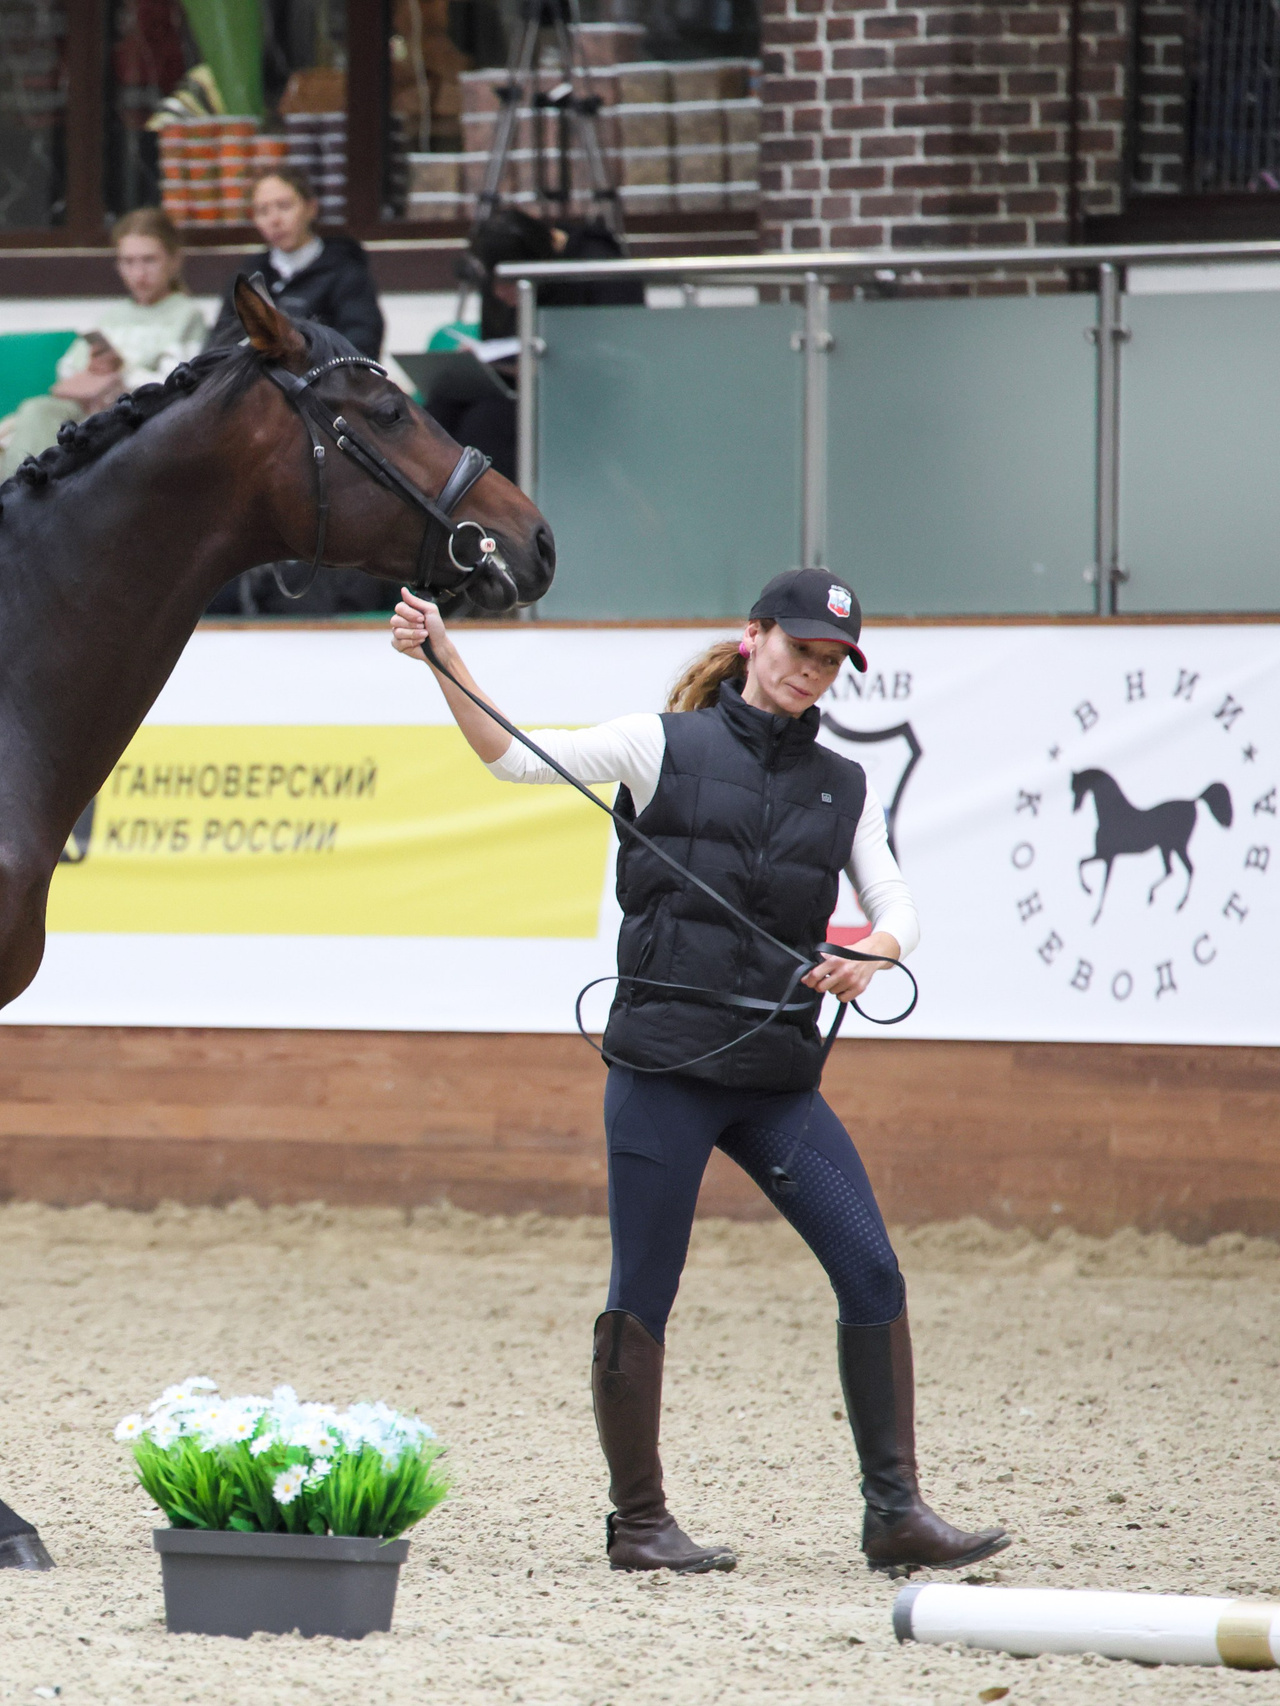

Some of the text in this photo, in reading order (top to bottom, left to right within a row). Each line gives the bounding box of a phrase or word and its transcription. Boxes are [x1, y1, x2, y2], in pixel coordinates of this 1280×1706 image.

[112, 759, 377, 797] ГАННОВЕРСКИЙ
[106, 820, 337, 852] КЛУБ РОССИИ
[1011, 668, 1278, 1002] ВНИИ КОНЕВОДСТВА
